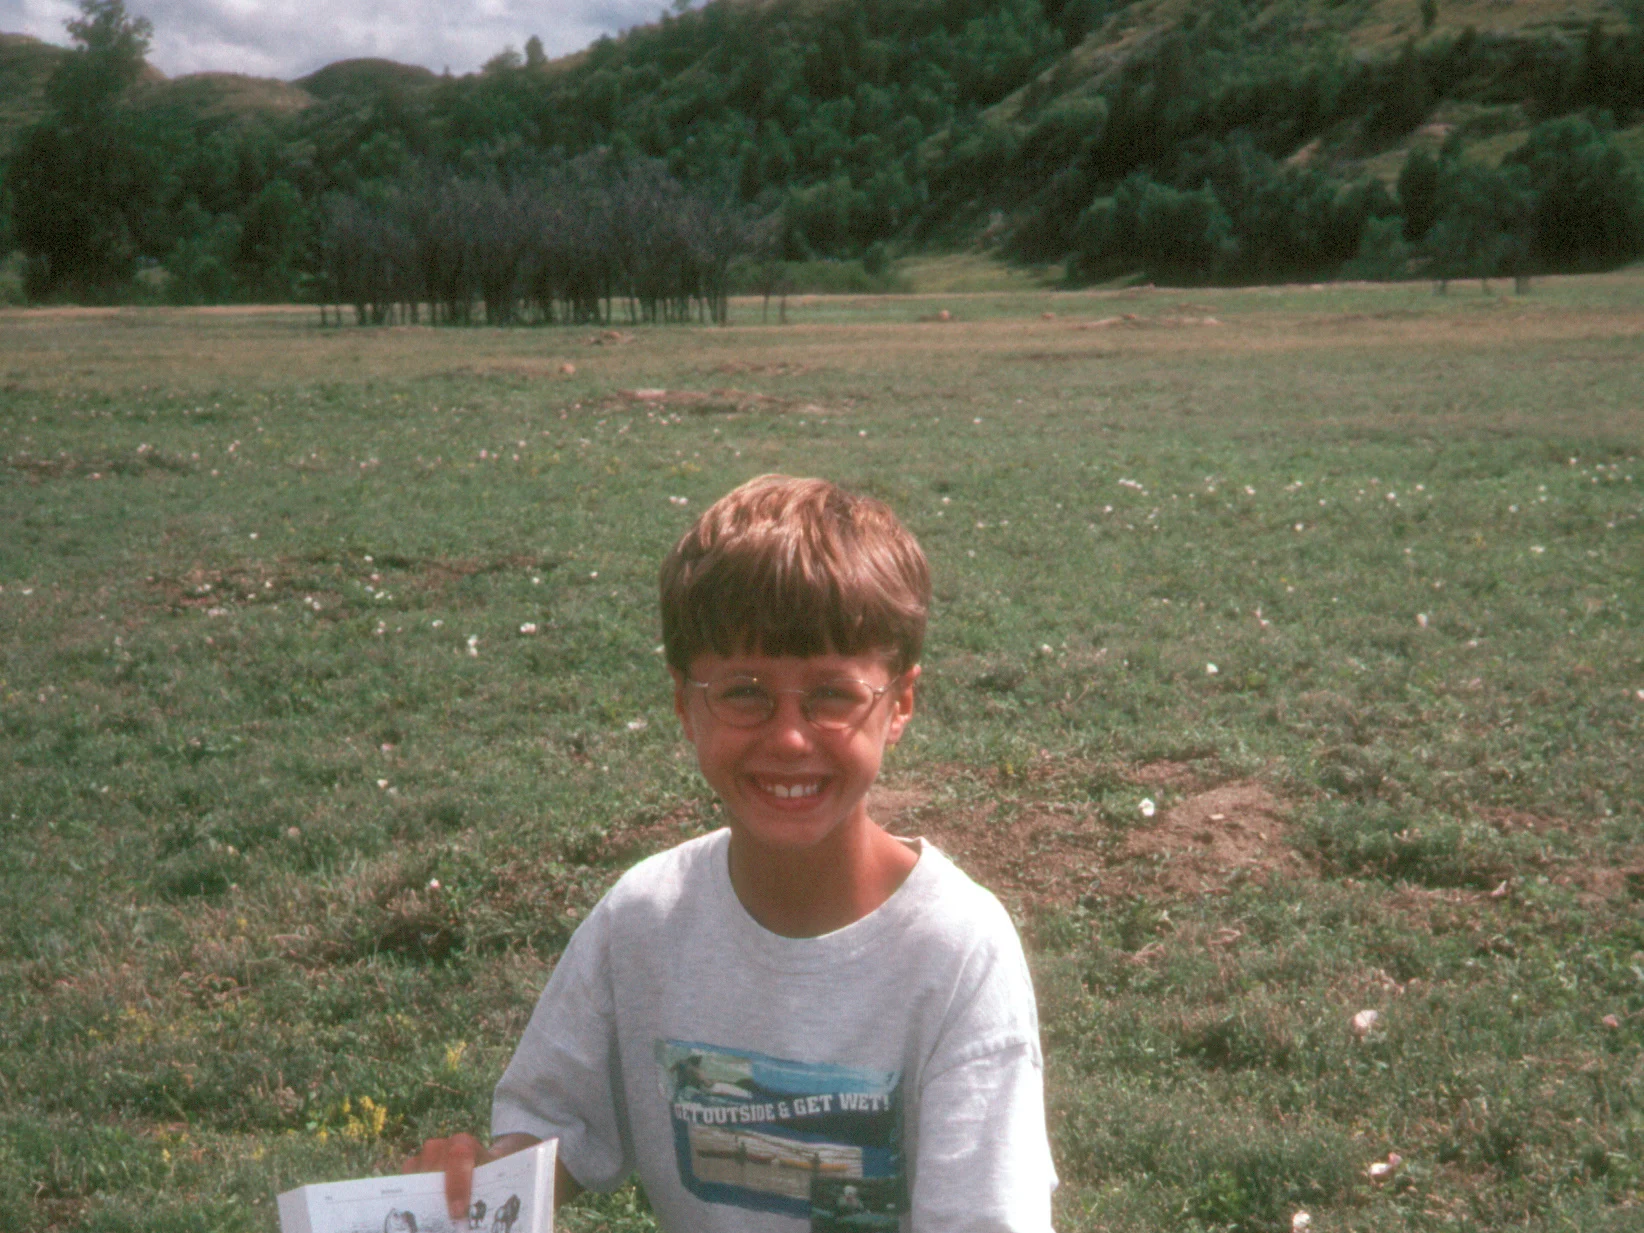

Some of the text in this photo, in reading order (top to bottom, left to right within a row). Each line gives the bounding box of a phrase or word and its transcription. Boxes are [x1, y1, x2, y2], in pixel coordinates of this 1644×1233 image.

[703, 1104, 776, 1124] OUTSIDE
[777, 1101, 791, 1119] &
[793, 1094, 831, 1116] GET
[838, 1092, 890, 1111] WET!
